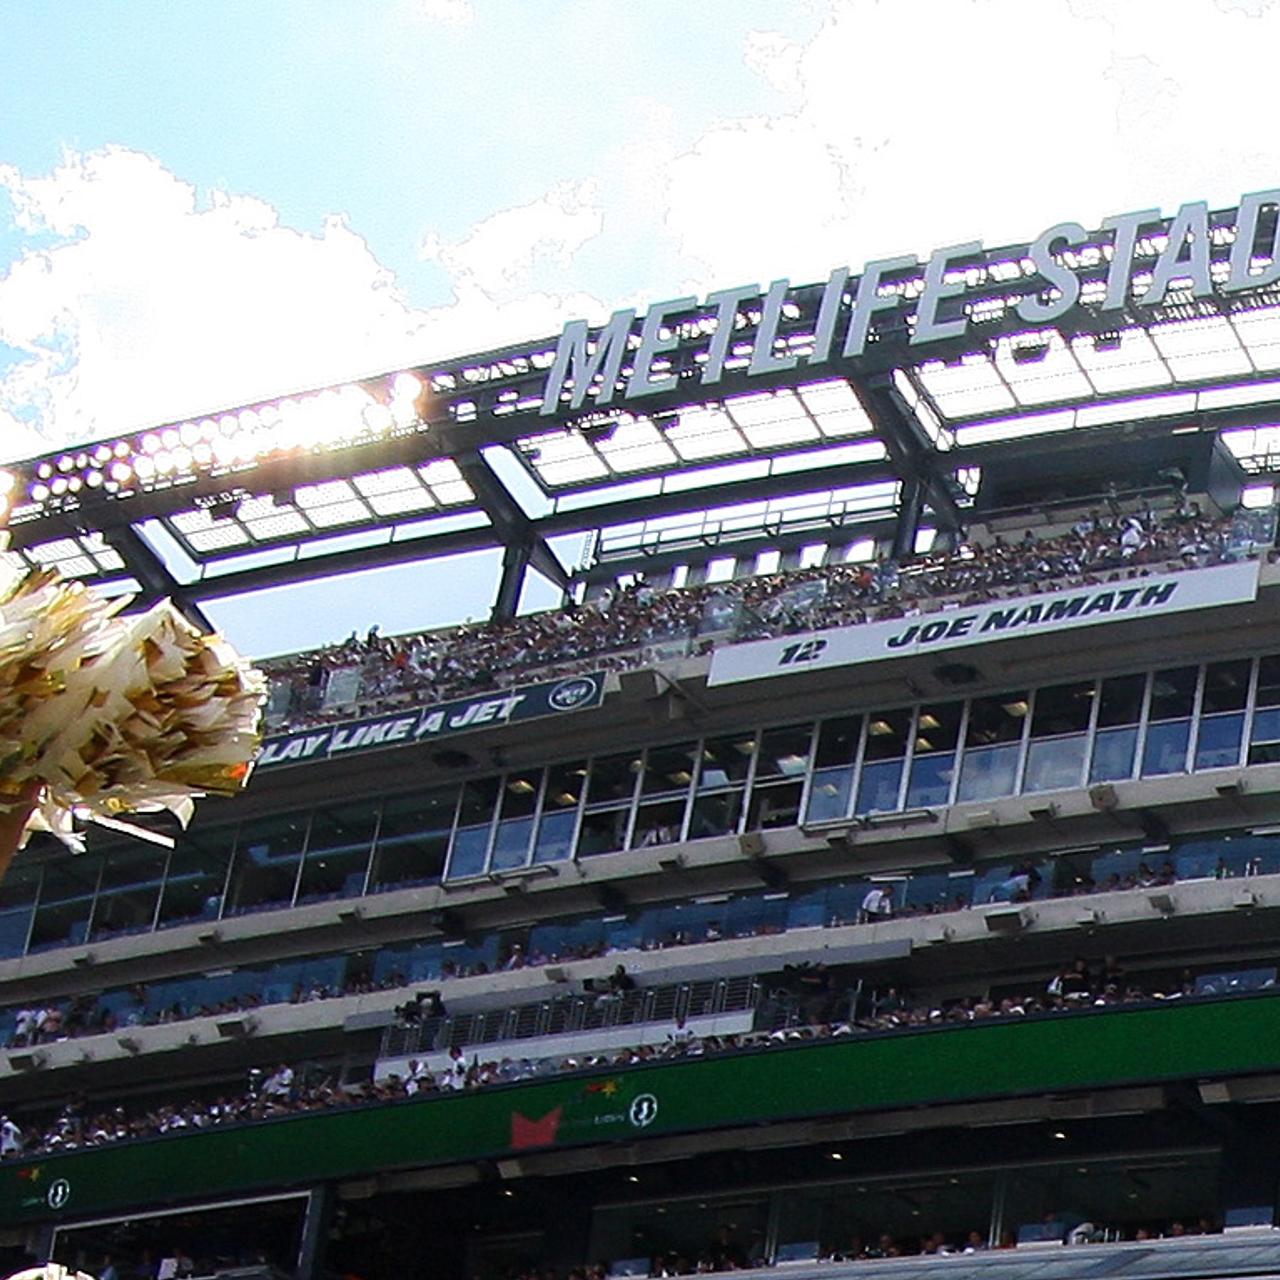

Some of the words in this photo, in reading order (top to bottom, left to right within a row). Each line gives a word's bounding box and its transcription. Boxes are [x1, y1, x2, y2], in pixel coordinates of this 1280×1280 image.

[539, 240, 984, 416] METLIFE
[778, 640, 828, 666] 12
[886, 615, 978, 649] JOE
[979, 582, 1179, 633] NAMATH
[258, 733, 328, 765] LAY
[327, 717, 417, 752] LIKE
[414, 710, 442, 738] A
[449, 694, 527, 729] JET
